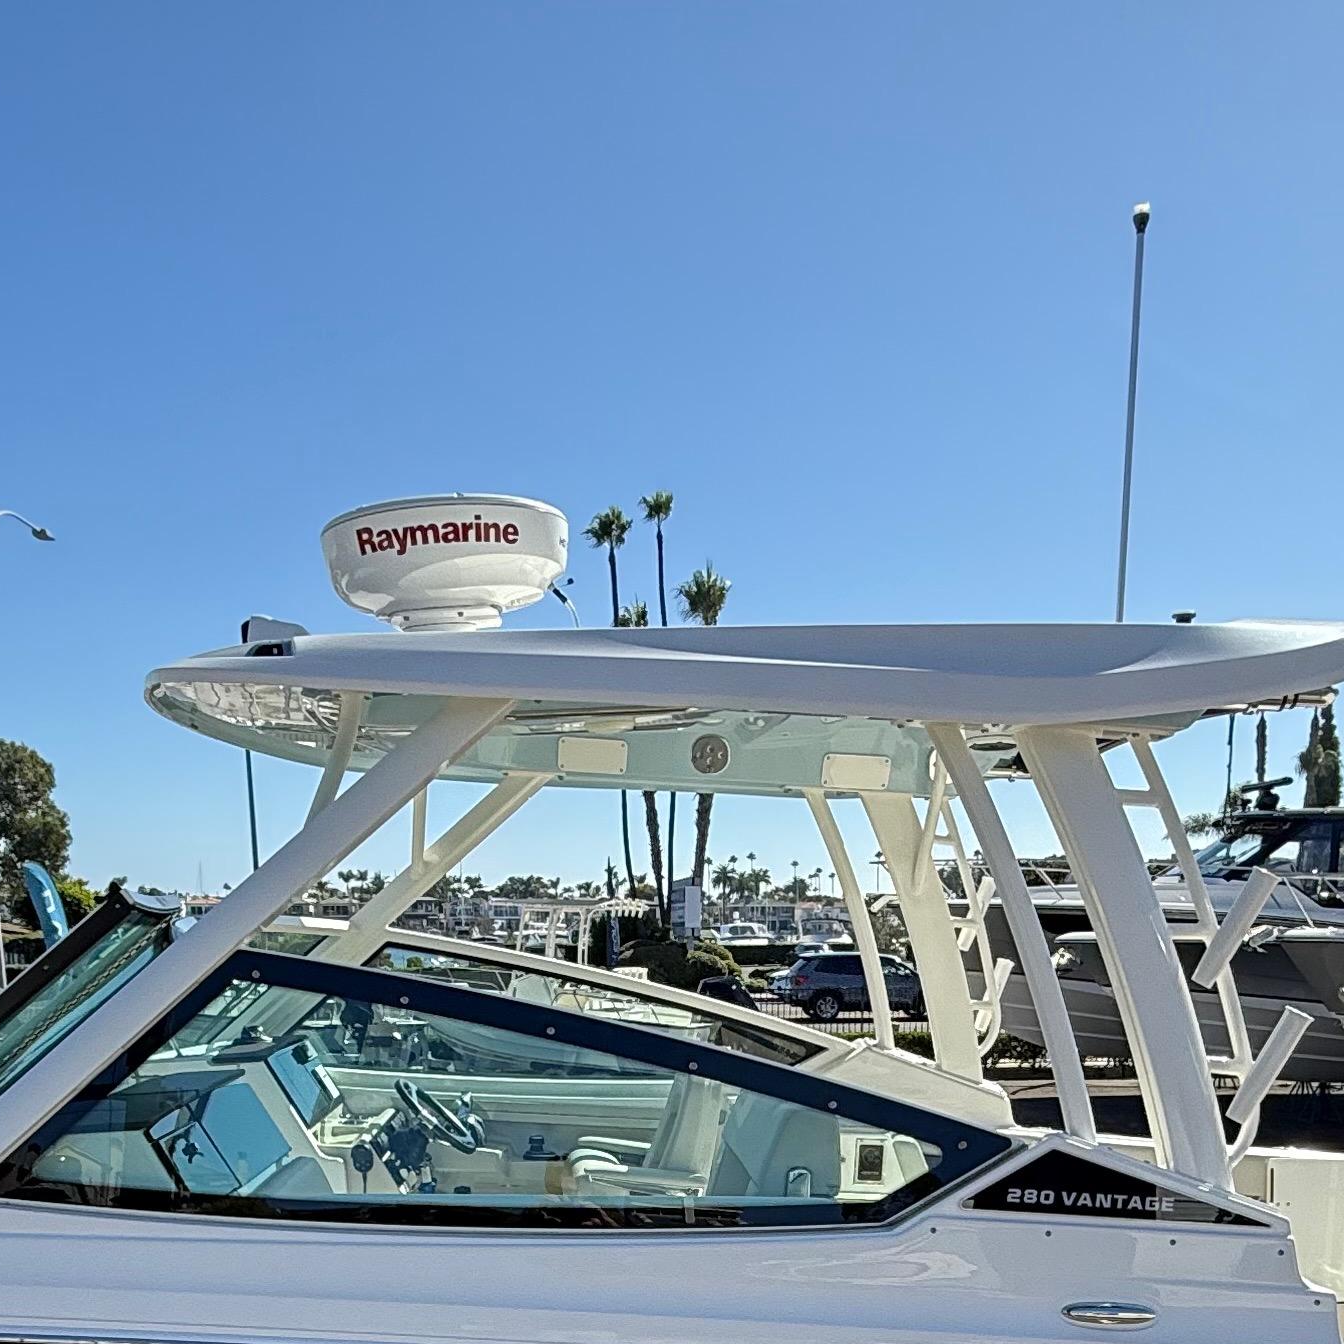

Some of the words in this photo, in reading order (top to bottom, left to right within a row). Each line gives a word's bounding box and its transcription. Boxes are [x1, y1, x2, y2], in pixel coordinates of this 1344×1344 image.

[355, 513, 520, 557] Raymarine
[1006, 1188, 1055, 1205] 280
[1061, 1191, 1175, 1212] VANTAGE
